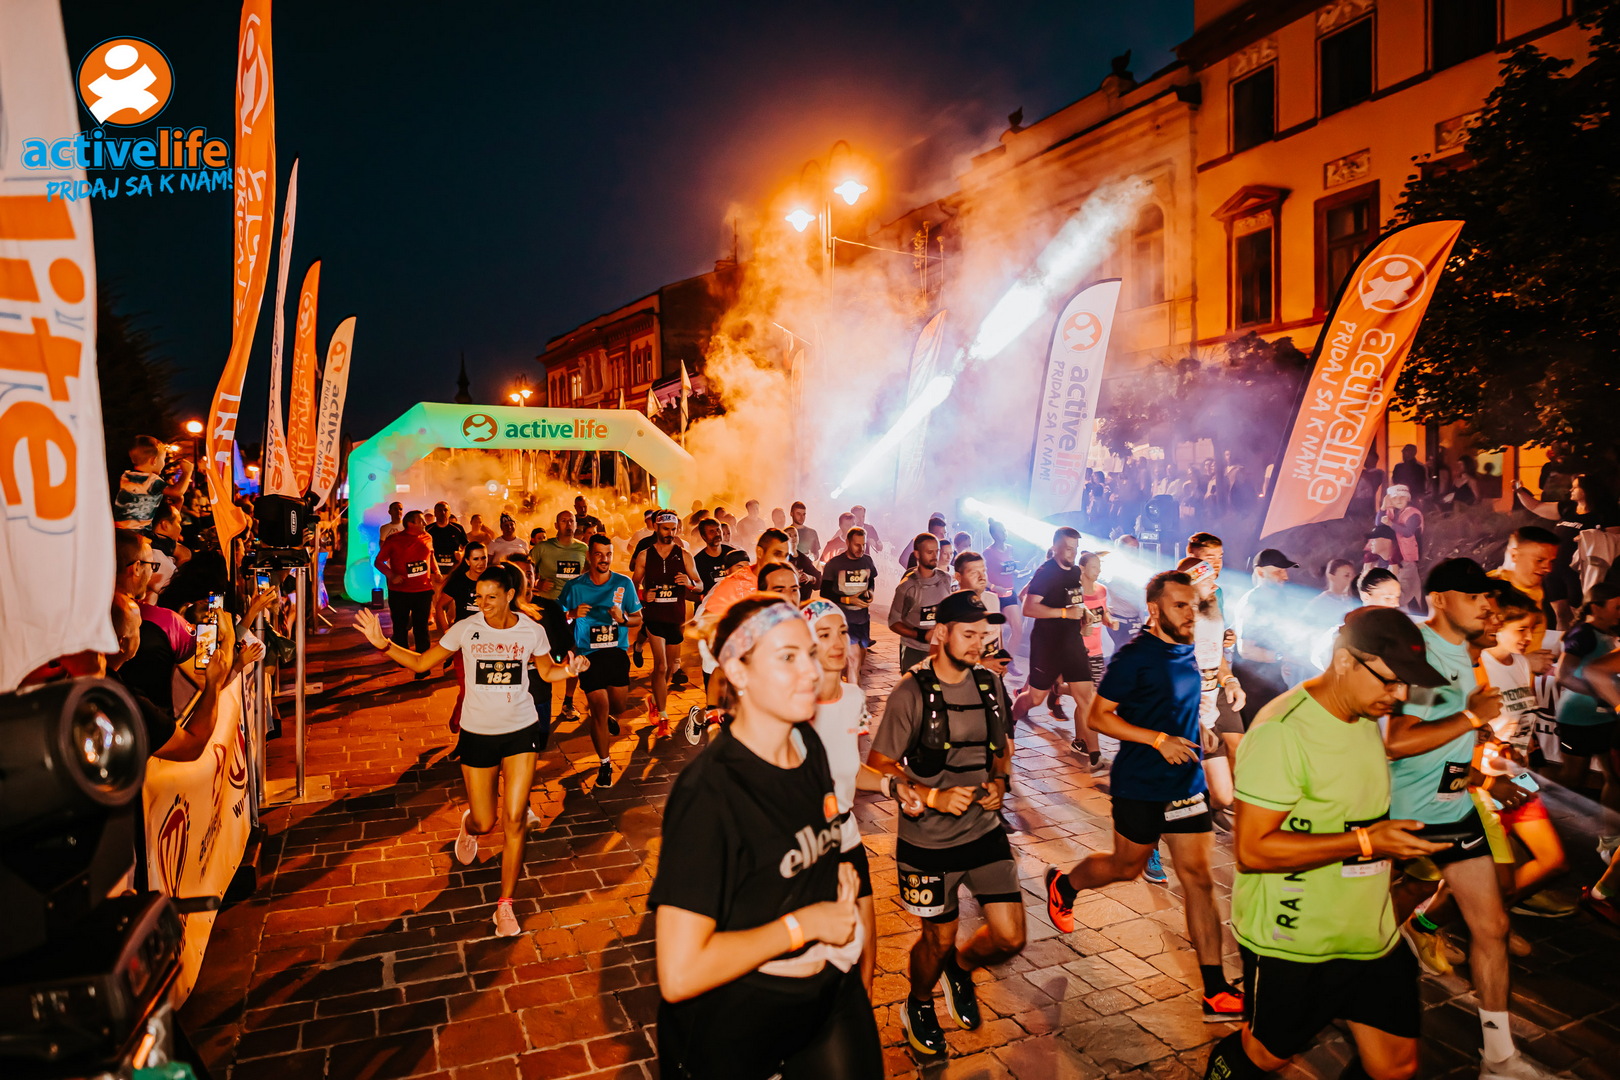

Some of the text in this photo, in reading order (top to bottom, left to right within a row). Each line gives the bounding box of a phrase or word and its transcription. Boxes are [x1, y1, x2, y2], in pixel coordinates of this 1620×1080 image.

[1321, 320, 1356, 385] PRIDAJ
[1048, 360, 1065, 409] PRIDAJ
[321, 379, 332, 418] PRIDAJ
[1309, 387, 1333, 412] SA
[1044, 411, 1058, 429] SA
[1305, 416, 1325, 432] K
[1307, 328, 1394, 504] activelife
[319, 384, 341, 490] activelife
[320, 421, 327, 436] SA
[504, 417, 608, 440] activelife
[1043, 434, 1055, 444] K
[1053, 365, 1089, 496] activelife
[318, 439, 325, 448] K
[659, 590, 673, 598] 110
[486, 672, 512, 684] 182
[1272, 817, 1312, 942] TRAING
[903, 886, 934, 906] 390
